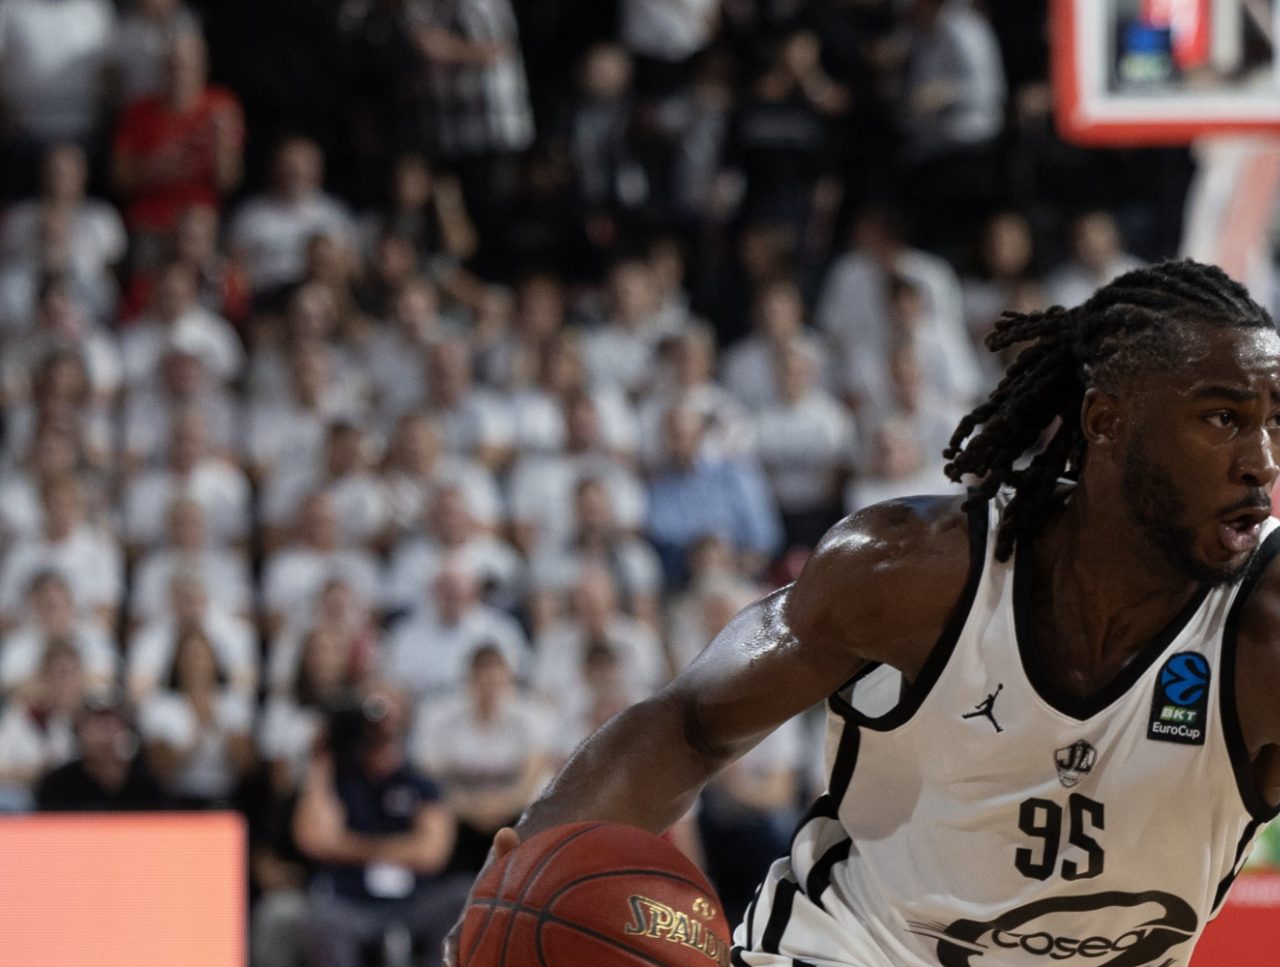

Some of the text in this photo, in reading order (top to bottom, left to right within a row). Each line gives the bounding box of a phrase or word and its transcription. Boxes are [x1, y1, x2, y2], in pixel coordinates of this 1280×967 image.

[1160, 706, 1196, 722] BKT
[1152, 721, 1200, 740] EuroCup
[1014, 792, 1105, 881] 95
